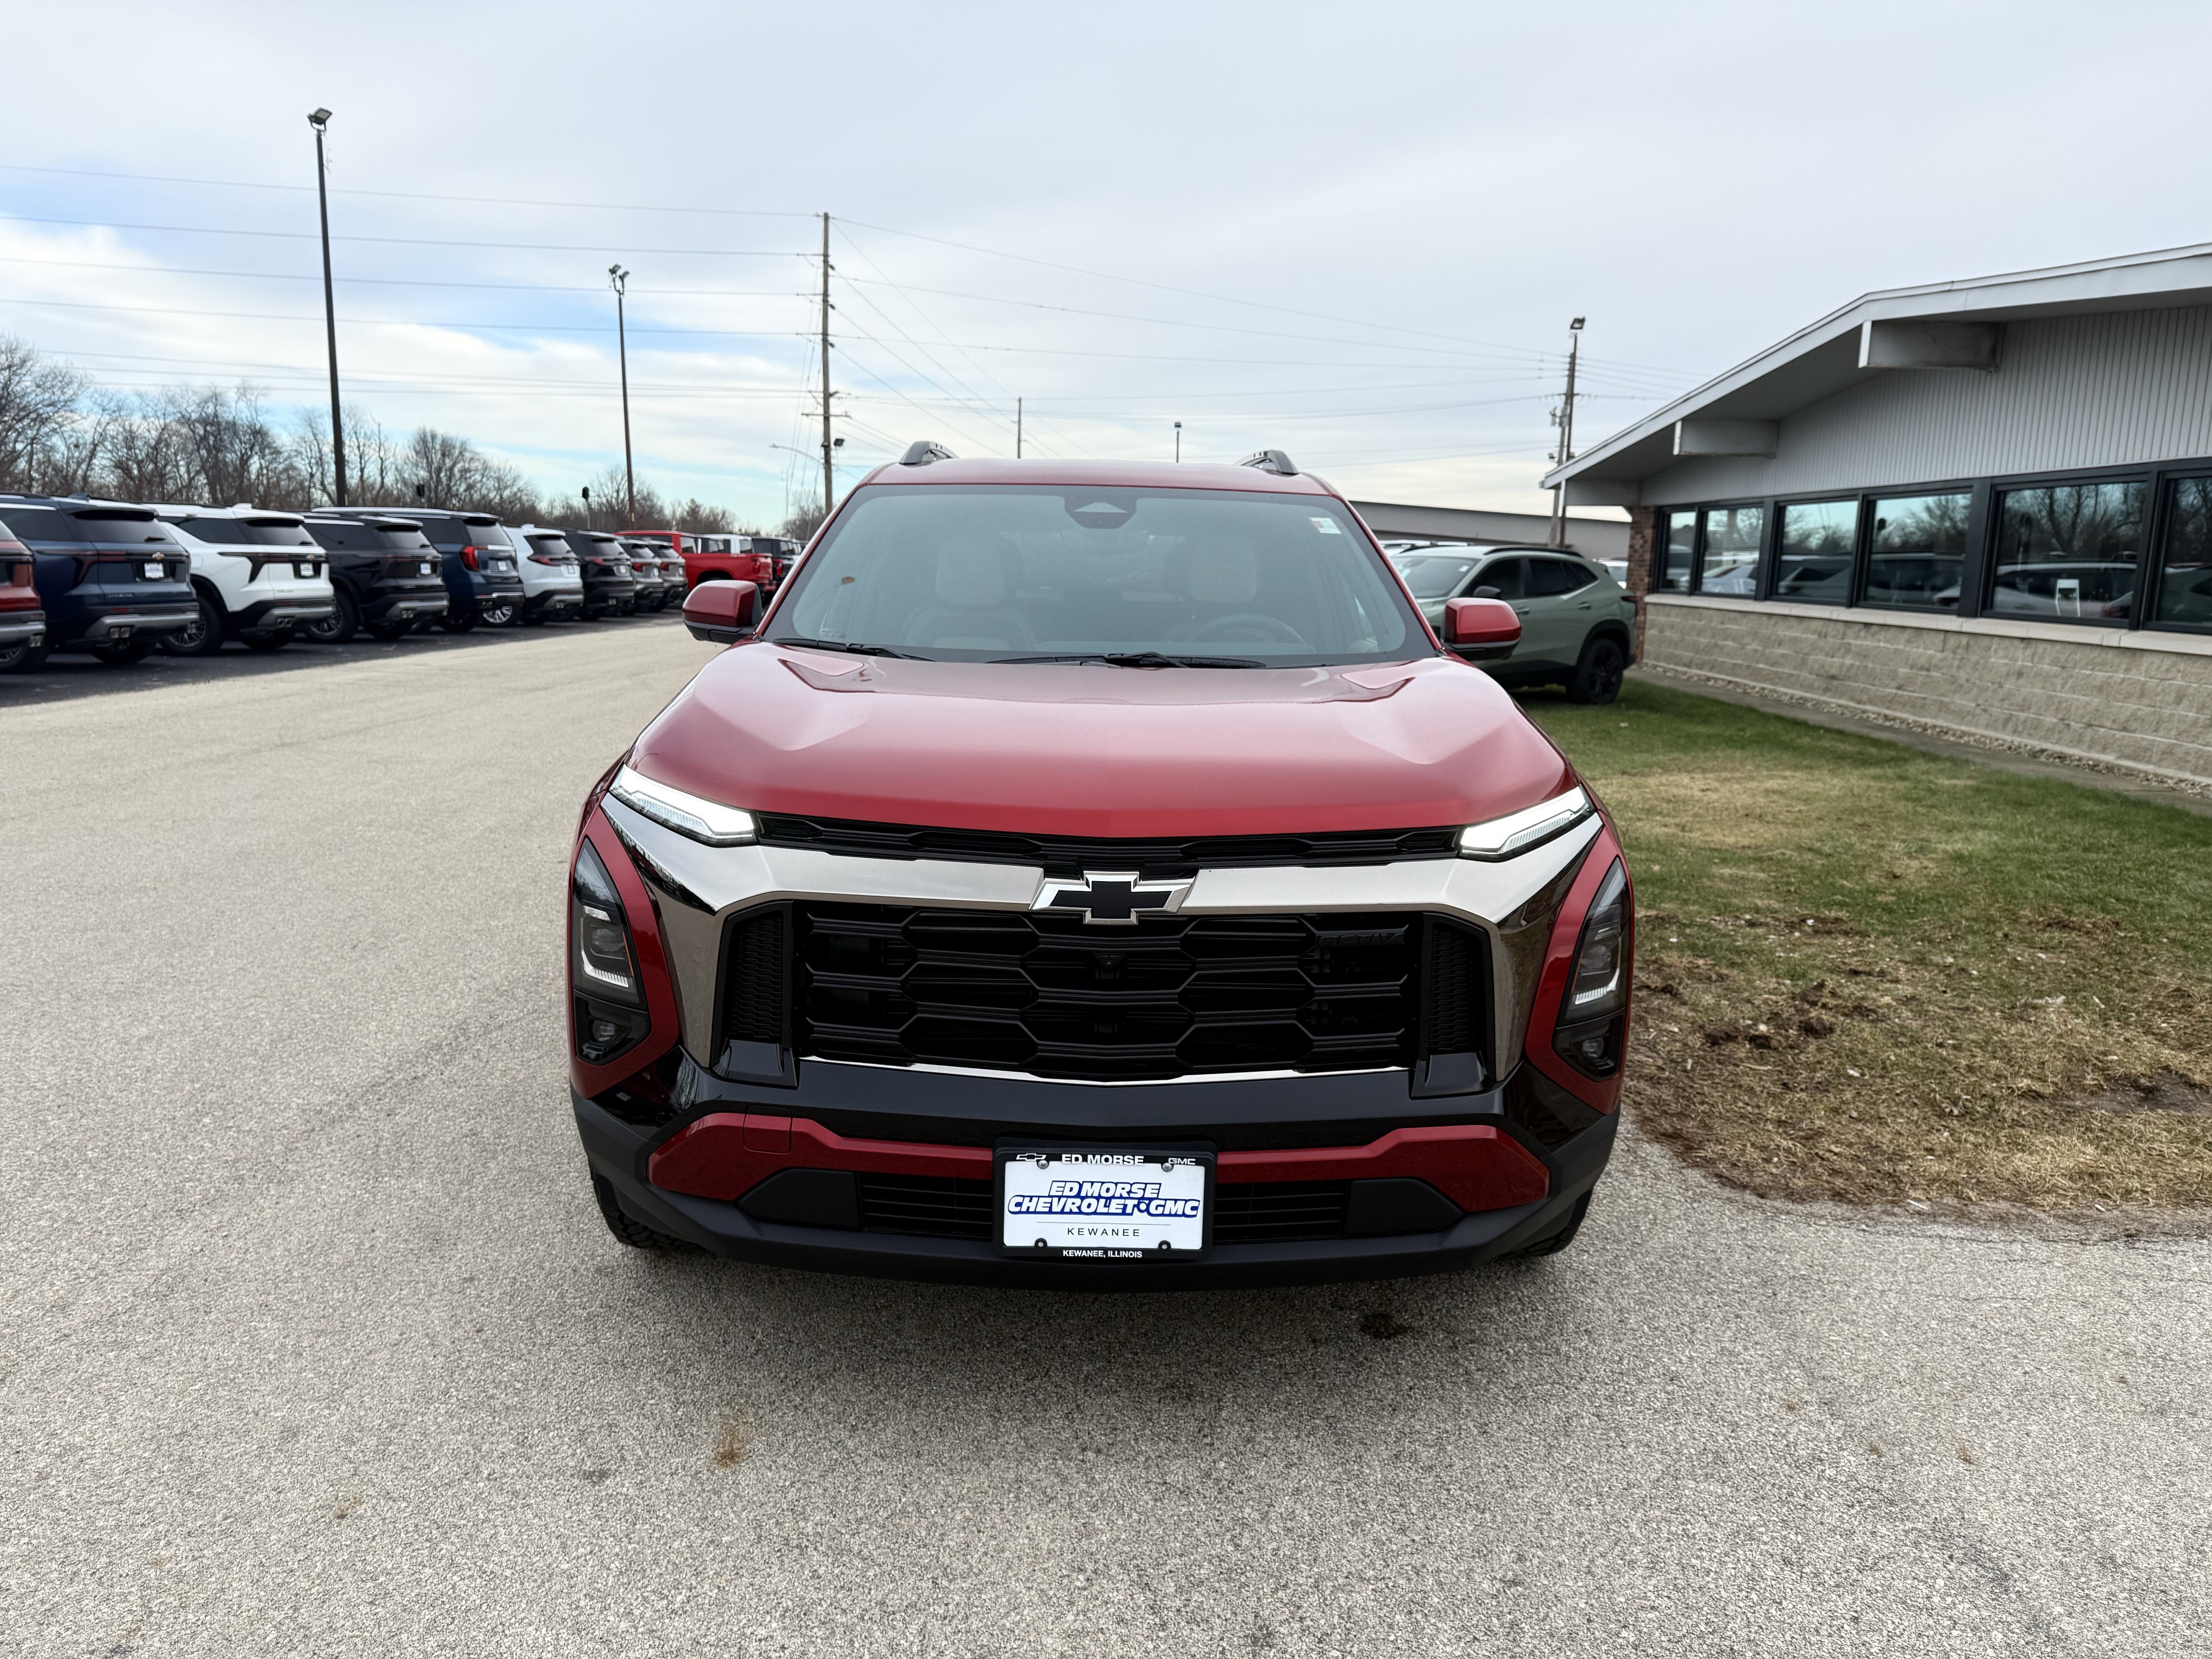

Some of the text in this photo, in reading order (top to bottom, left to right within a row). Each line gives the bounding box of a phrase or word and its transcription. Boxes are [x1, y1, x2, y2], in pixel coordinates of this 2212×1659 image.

[1318, 934, 1401, 946] ACTIV
[1062, 1154, 1144, 1165] ED MORSE
[1049, 1181, 1161, 1198] ED MORSE
[1067, 1228, 1140, 1237] KEWANEE
[1063, 1250, 1106, 1258] KEWANEE,
